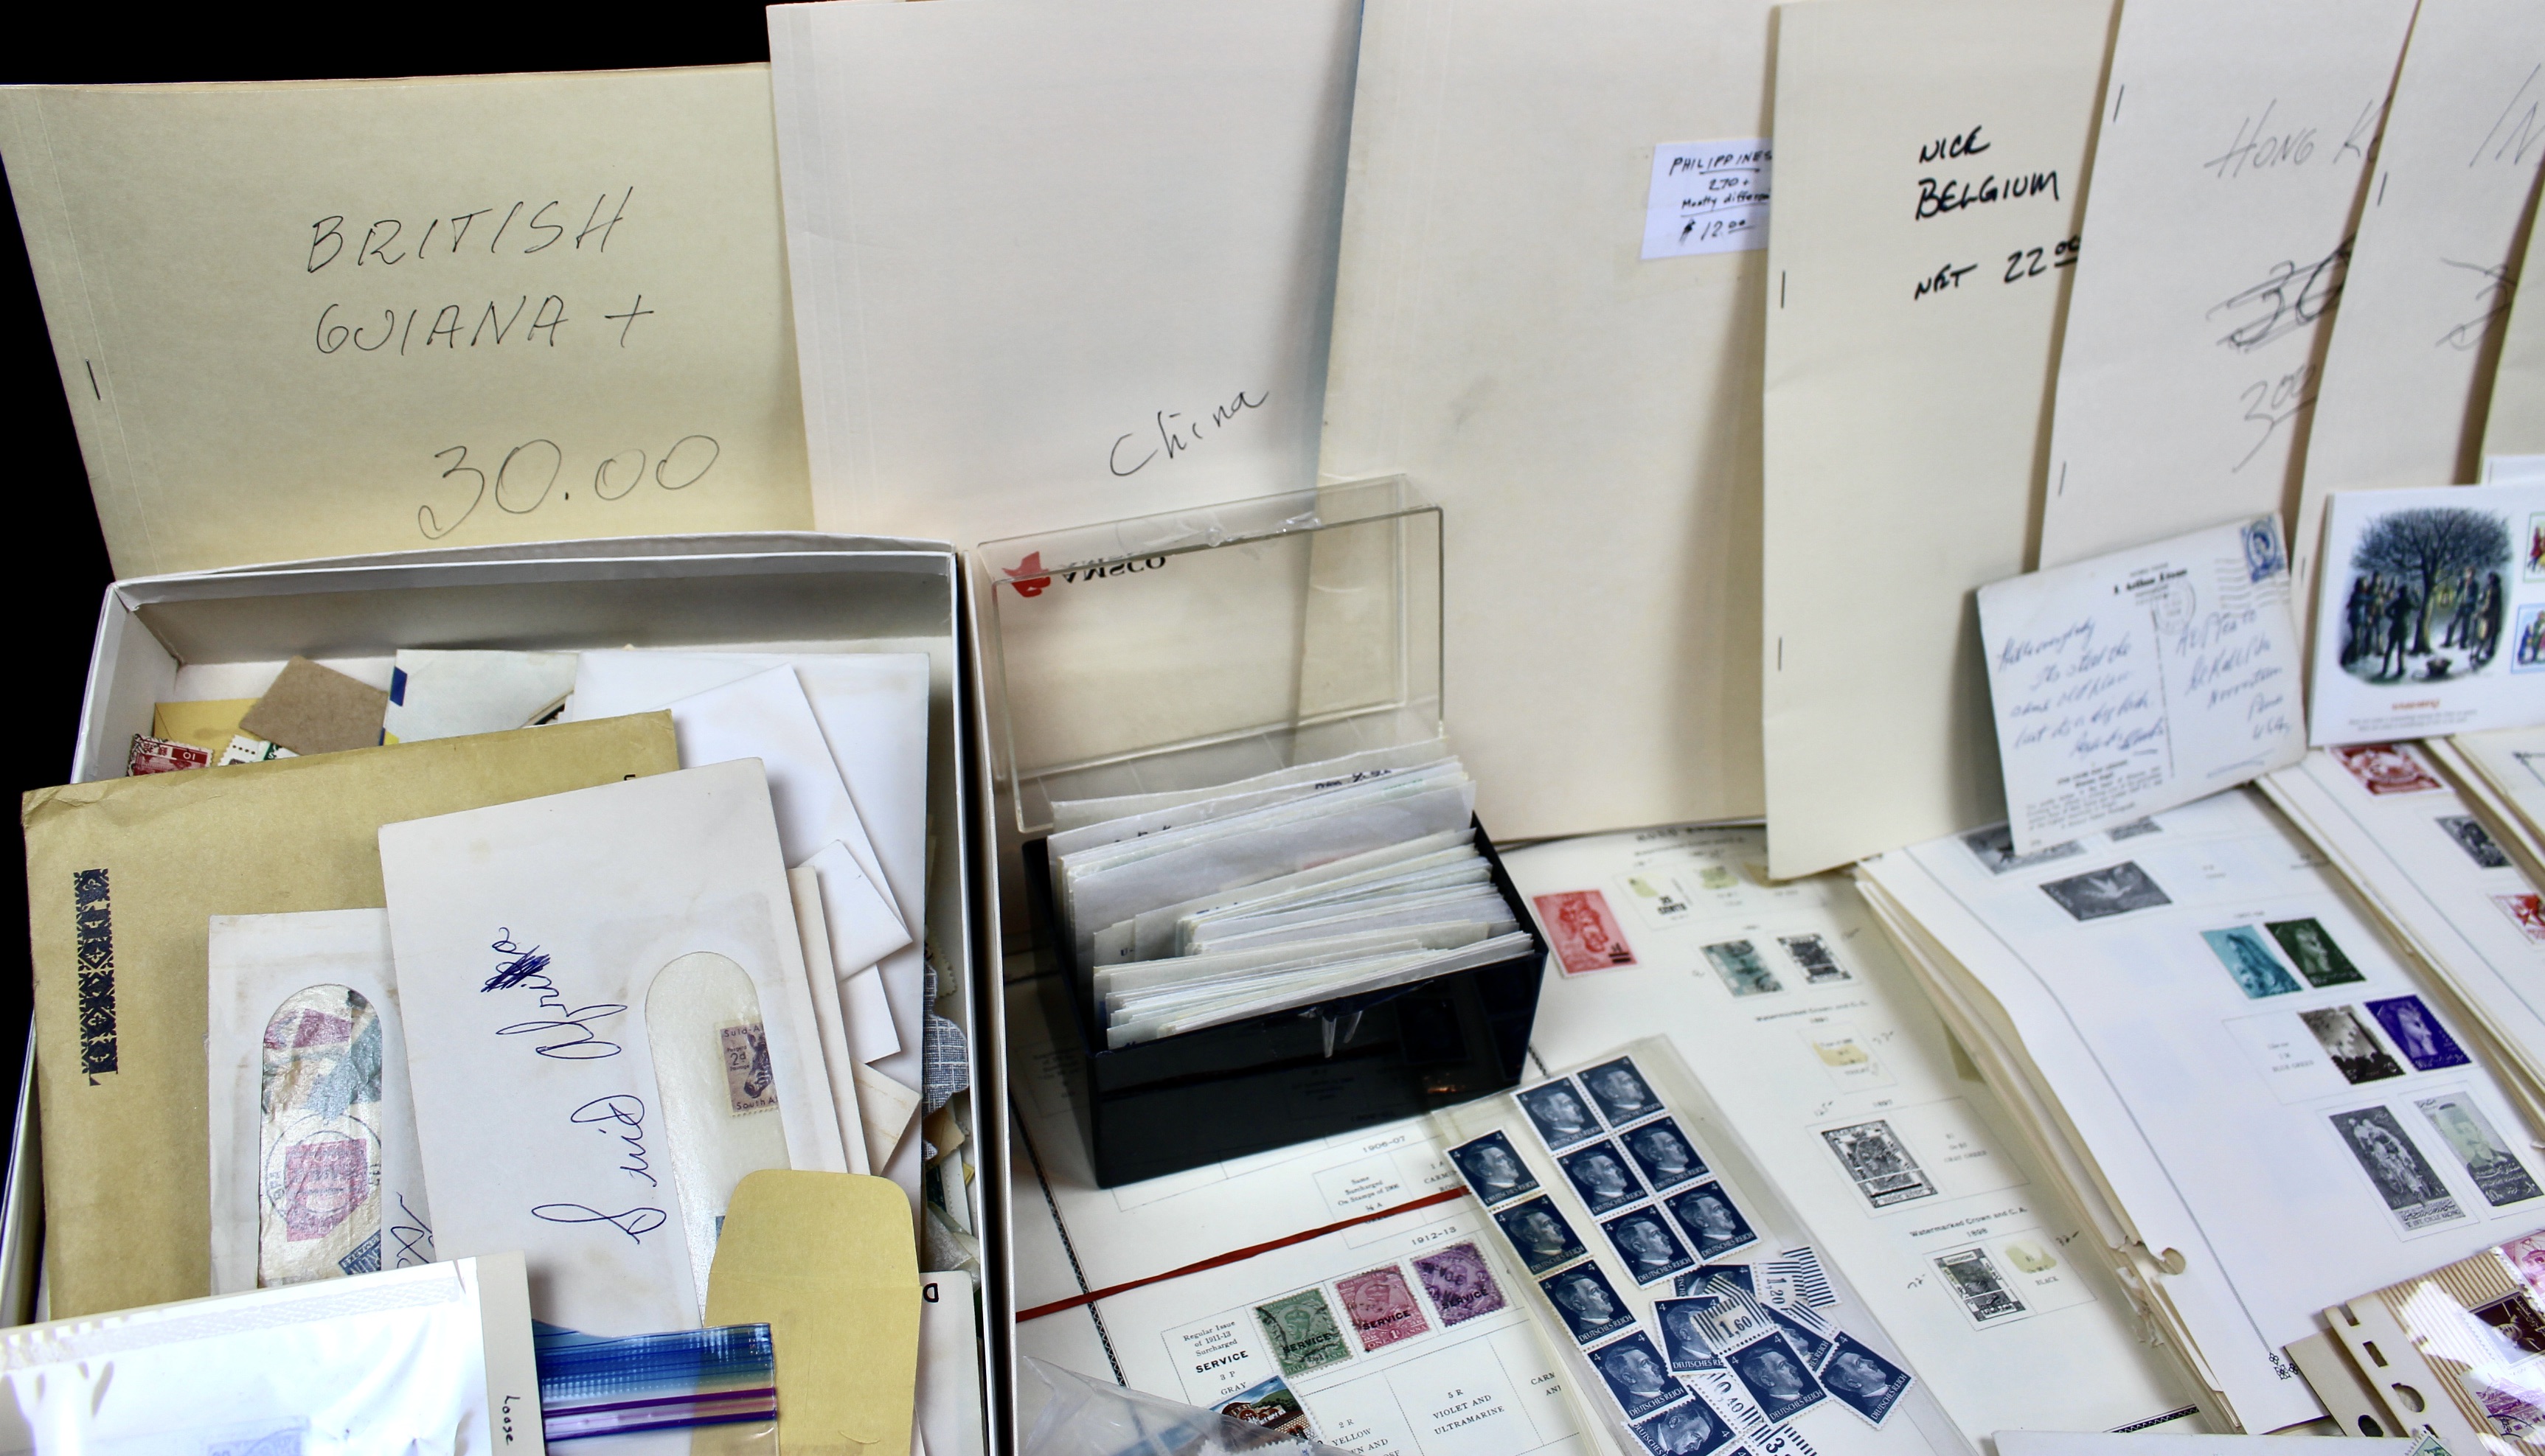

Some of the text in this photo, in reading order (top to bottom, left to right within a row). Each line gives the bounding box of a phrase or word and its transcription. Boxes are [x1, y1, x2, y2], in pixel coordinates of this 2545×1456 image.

[1919, 125, 1990, 163] NICE
[2204, 98, 2317, 178] HONG
[1915, 170, 2060, 220] BELGIUM
[306, 187, 633, 273] BRITISH
[1914, 263, 1978, 301] NET
[317, 294, 654, 355] GUIANA +
[1109, 389, 1271, 477] China
[418, 434, 721, 540] 30.00
[736, 1099, 766, 1111] South
[1363, 1135, 1406, 1154] 1906-07
[1411, 1226, 1457, 1246] 1912-13
[1701, 1232, 1754, 1258] DEUTSCHES REICH
[1530, 1245, 1584, 1272] DEUTSCHES REICH
[1637, 1257, 1692, 1283] DEUTSCHES REICH
[1544, 1263, 1595, 1290] 4 4
[1441, 1289, 1489, 1310] SERVICE
[1765, 1278, 1787, 1304] 1,20
[1183, 1320, 1236, 1342] Regular Issue
[1363, 1310, 1412, 1331] SERVICE
[1577, 1314, 1632, 1342] DEUTSCHES REICH
[1718, 1315, 1753, 1339] 1,60
[1194, 1331, 1232, 1348] of 1911-13
[1195, 1339, 1238, 1357] Surcharged
[1282, 1332, 1333, 1354] SERVICE
[1594, 1333, 1645, 1362] 4 4
[1732, 1335, 1782, 1364] 4 4
[1816, 1340, 1830, 1361] REICH
[1195, 1350, 1249, 1373] SERVICE
[1673, 1359, 1712, 1369] DEUTSCHES
[1219, 1370, 1237, 1382] 3 P
[1221, 1381, 1247, 1396] GRAY
[1433, 1393, 1492, 1420] VIOLET AND
[1448, 1388, 1465, 1399] 5 R
[1628, 1386, 1684, 1417] DEUTSCHES REICH
[1768, 1389, 1823, 1421] DEUTSCHES REICH
[1870, 1373, 1908, 1421] DEUTSCHES REICH
[502, 1395, 521, 1446] Loose
[1338, 1418, 1355, 1429] 2 R
[1434, 1405, 1505, 1435] ULTRAMARINE
[1331, 1427, 1372, 1447] YELLOW
[1368, 1438, 1389, 1450] AND
